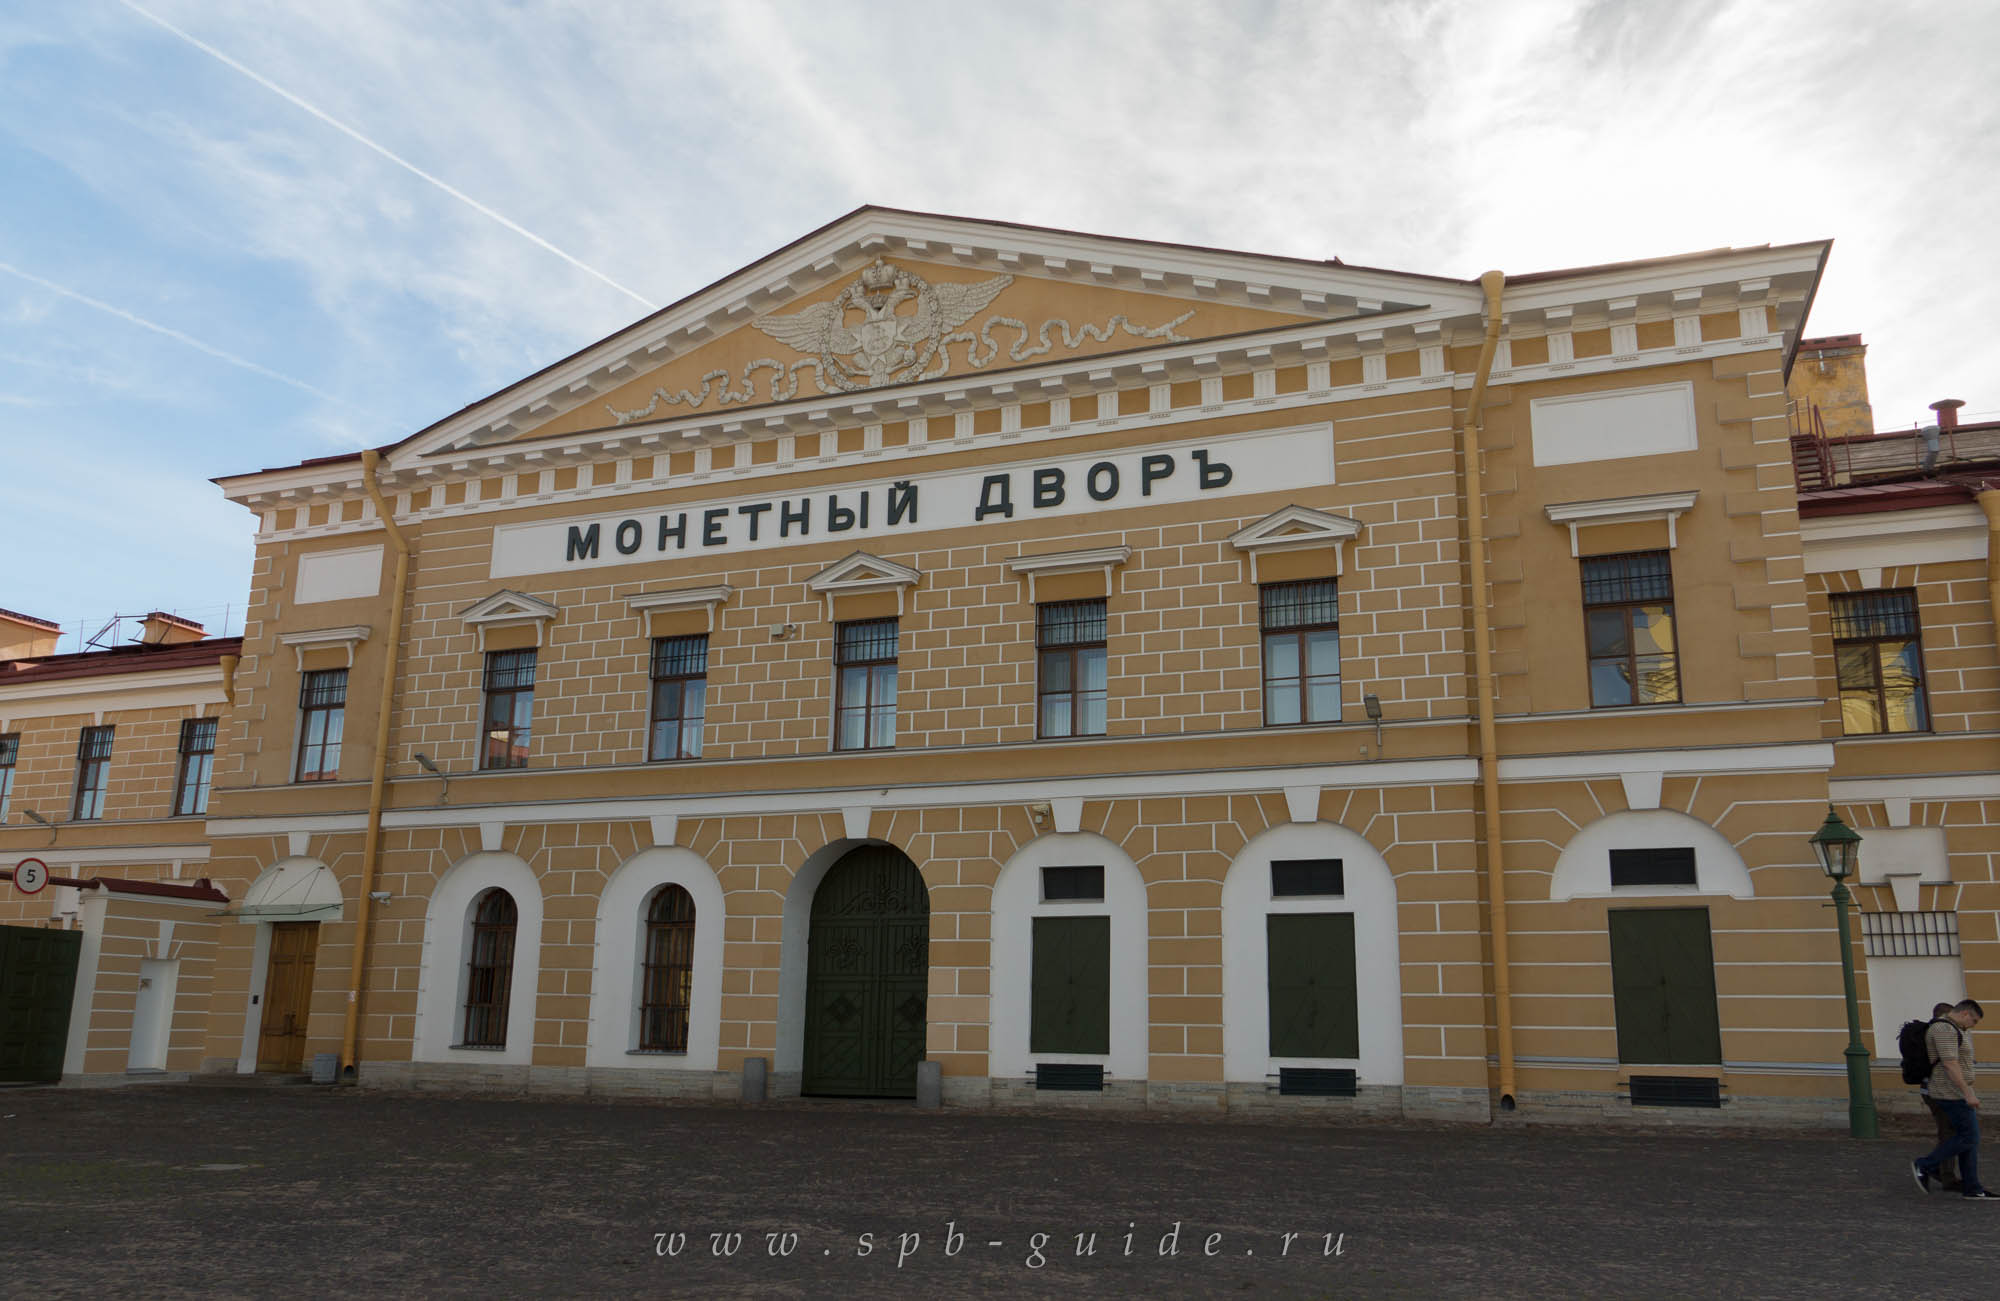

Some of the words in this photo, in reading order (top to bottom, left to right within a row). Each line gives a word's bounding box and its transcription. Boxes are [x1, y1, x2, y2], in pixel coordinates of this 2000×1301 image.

[566, 481, 918, 561] МОНЕТНЫЙ
[975, 449, 1234, 522] ДВОРЪ
[26, 869, 36, 883] 5
